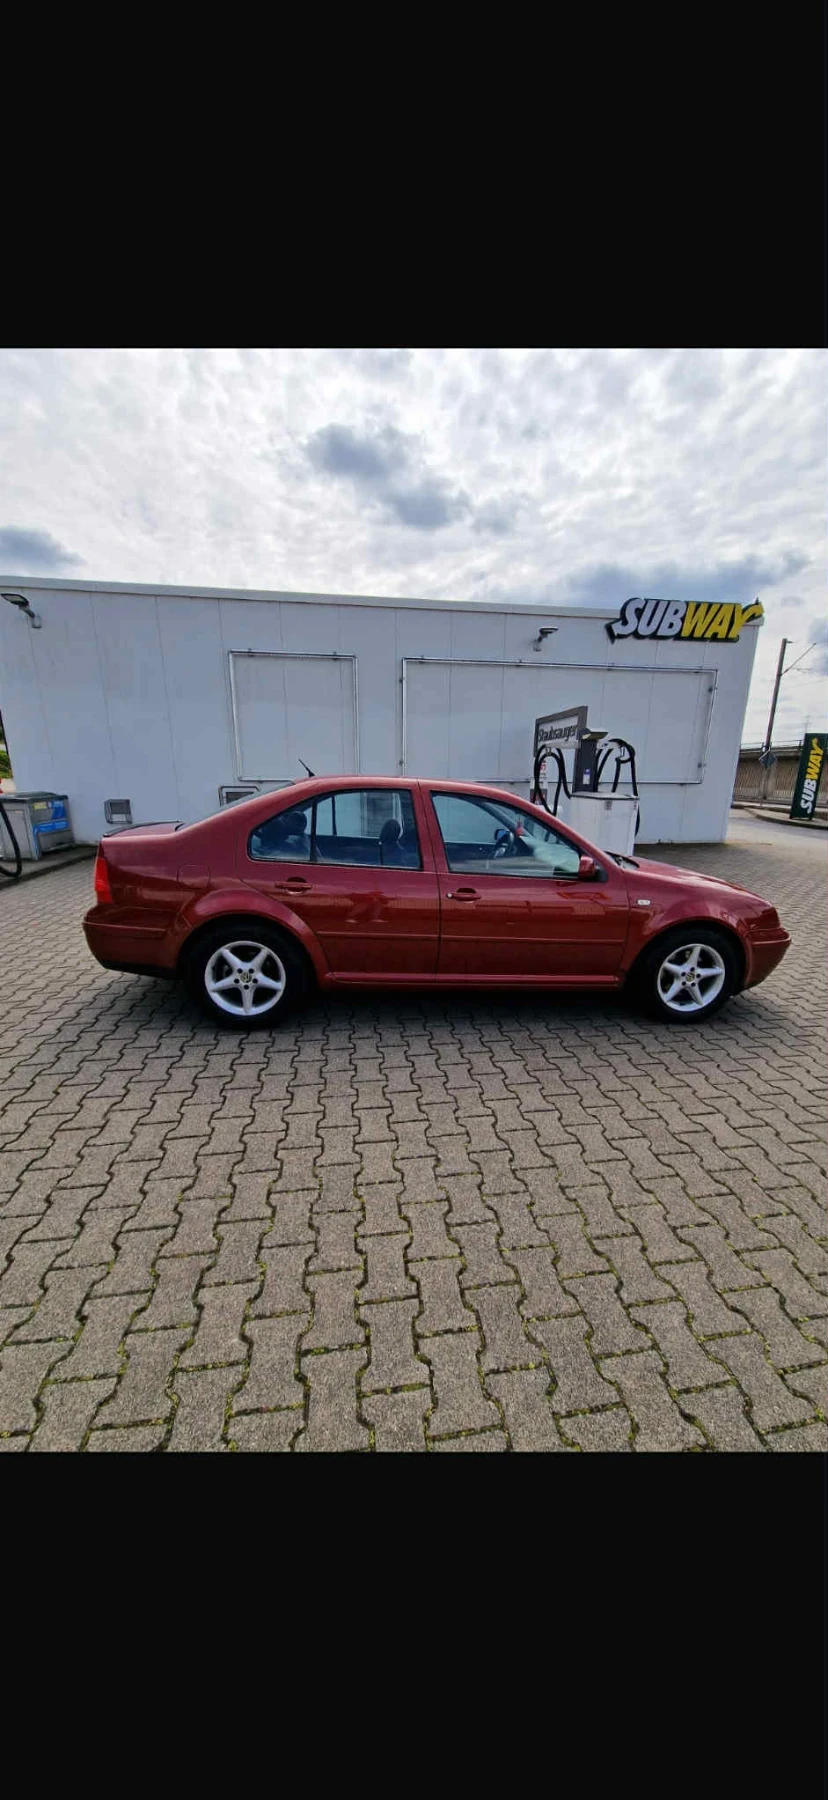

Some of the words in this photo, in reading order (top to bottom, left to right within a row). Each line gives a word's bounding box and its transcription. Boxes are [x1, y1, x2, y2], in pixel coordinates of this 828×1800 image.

[608, 598, 765, 642] SUBWAY
[539, 725, 578, 741] Staubsauger
[801, 737, 824, 814] SUBWAY
